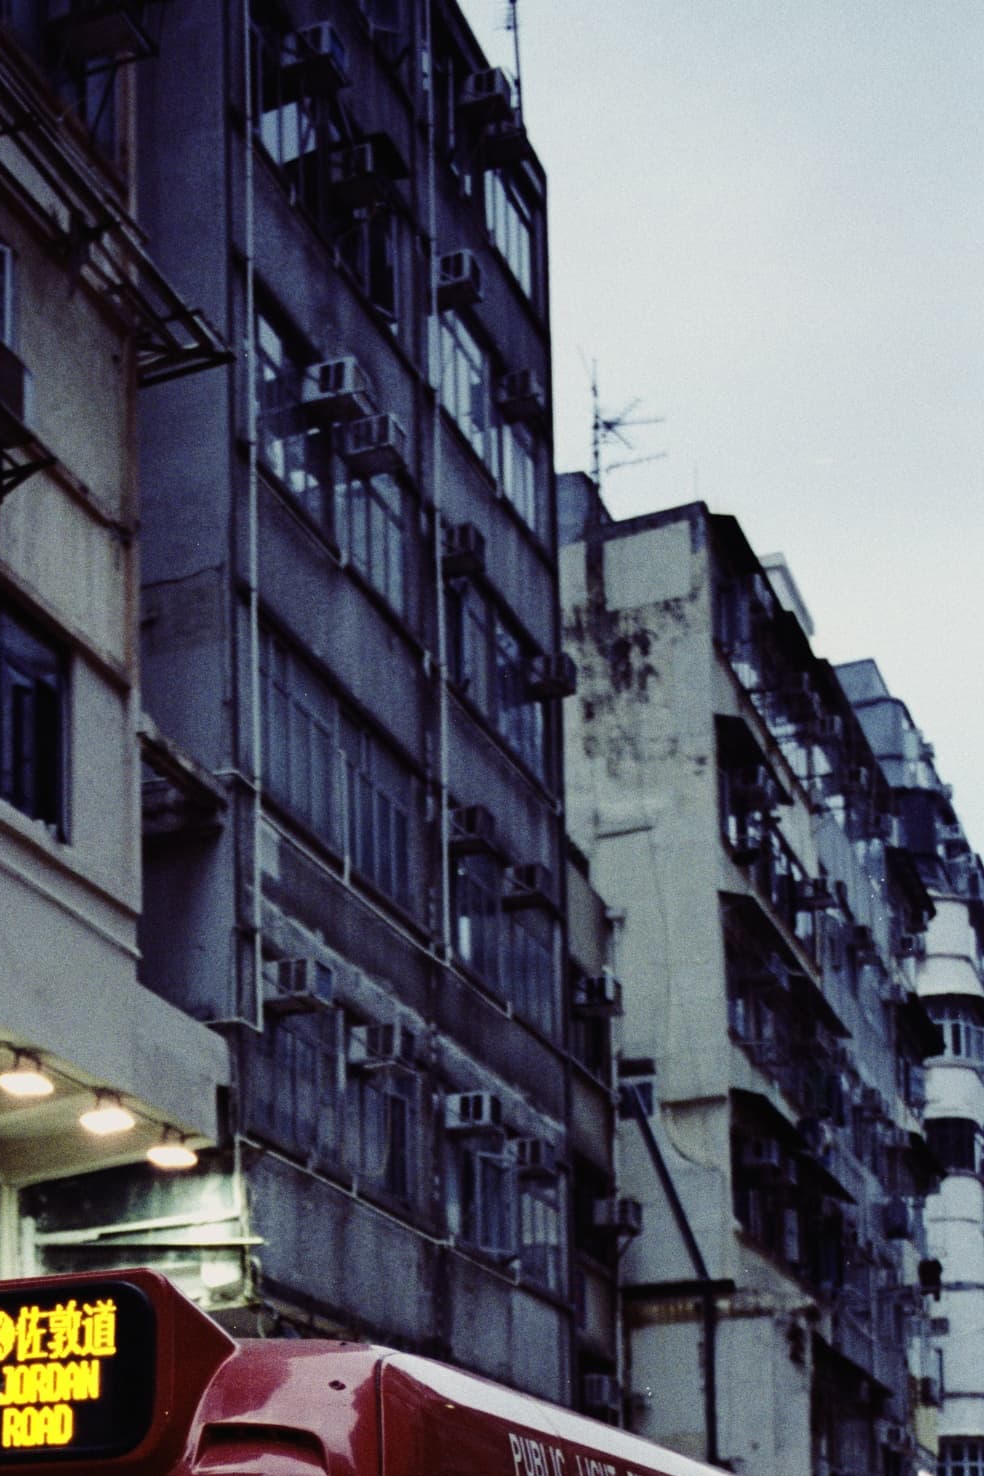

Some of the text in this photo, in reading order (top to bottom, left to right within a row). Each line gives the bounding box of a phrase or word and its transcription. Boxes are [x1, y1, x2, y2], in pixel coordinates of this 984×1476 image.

[16, 1299, 117, 1361] 佐敦道
[2, 1404, 74, 1448] ROAD
